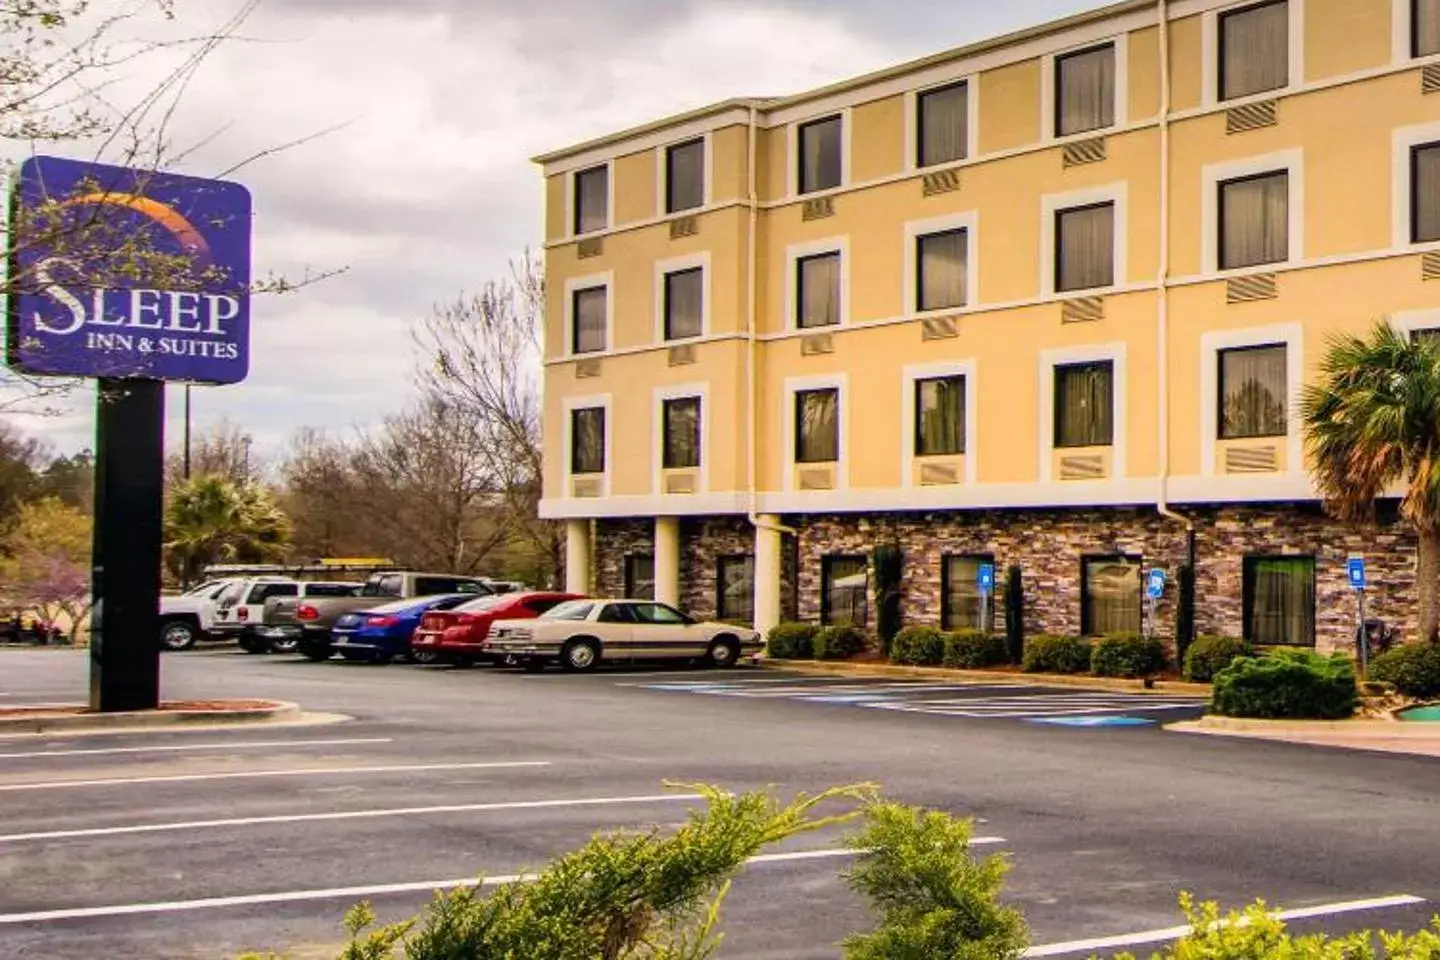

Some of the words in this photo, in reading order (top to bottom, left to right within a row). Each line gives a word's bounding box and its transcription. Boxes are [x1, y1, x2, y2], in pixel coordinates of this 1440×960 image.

[34, 257, 239, 335] SLEEP
[86, 332, 133, 351] INN
[138, 337, 154, 352] &
[158, 337, 238, 359] SUITES
